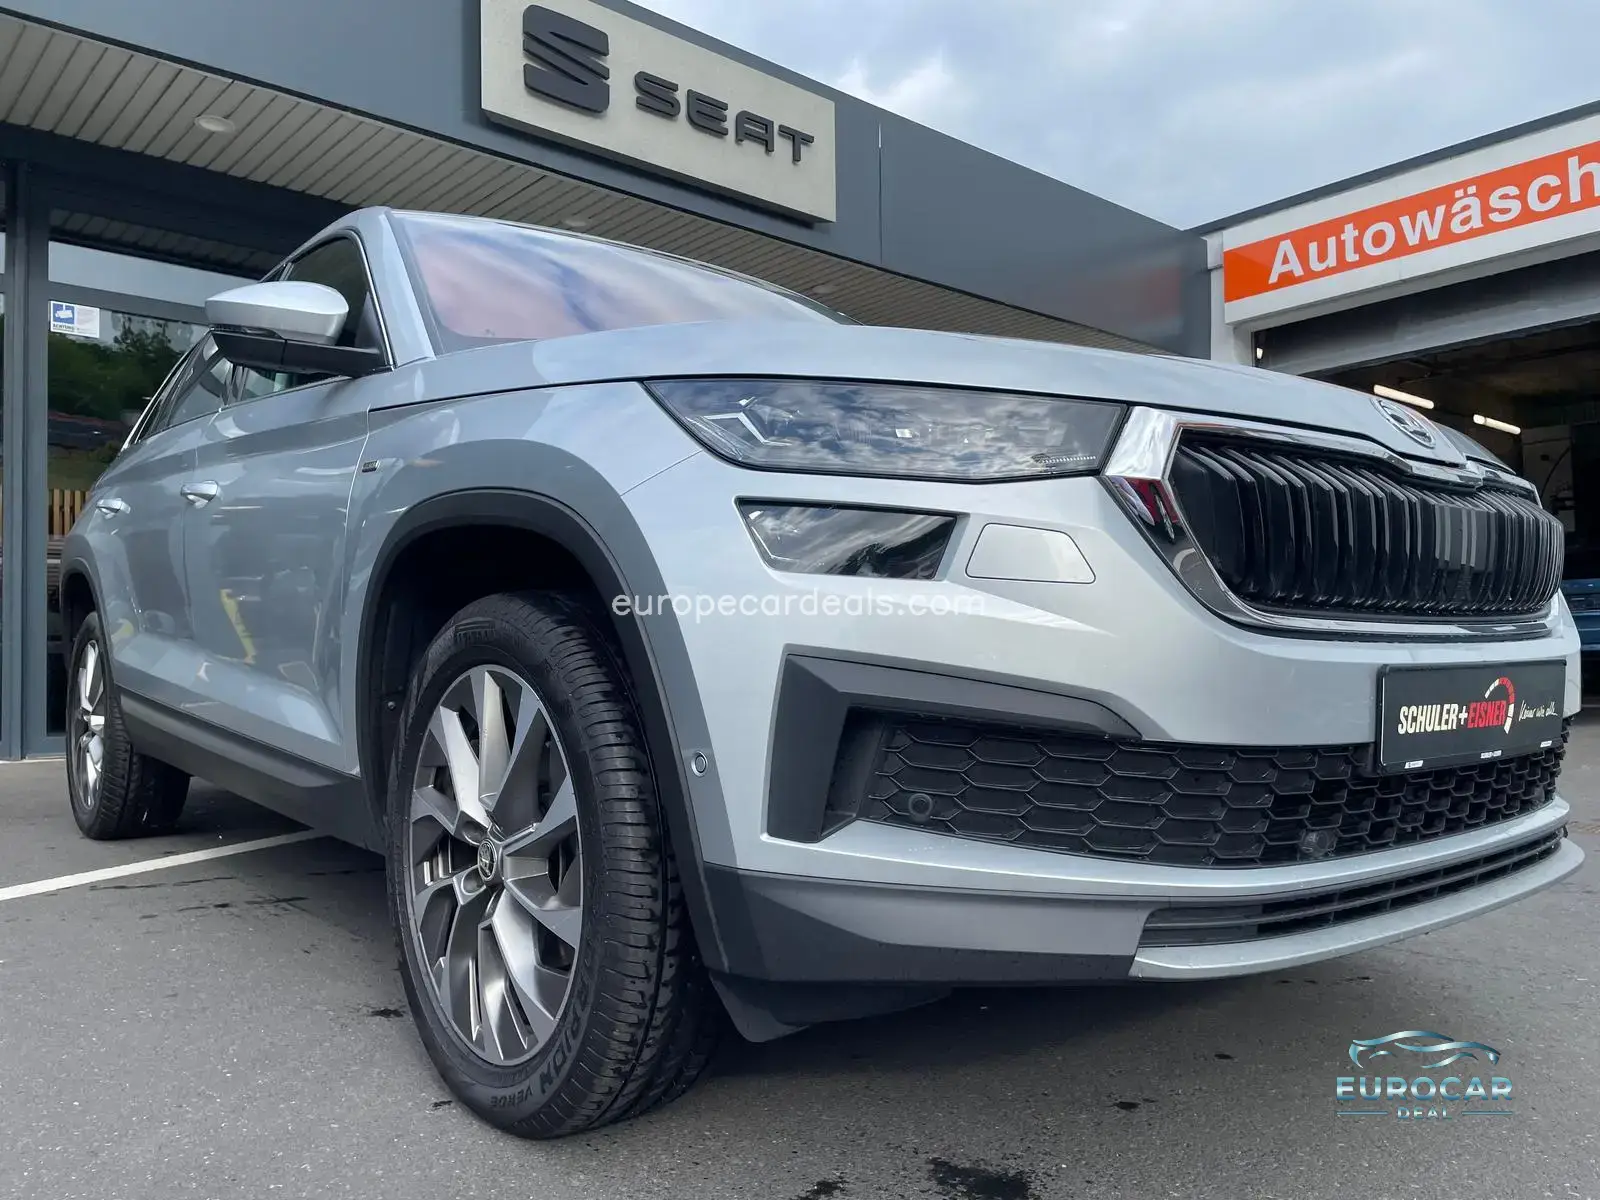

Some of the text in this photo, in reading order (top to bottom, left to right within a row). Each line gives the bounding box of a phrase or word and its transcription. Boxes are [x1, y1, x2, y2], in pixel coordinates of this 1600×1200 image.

[634, 70, 815, 163] SEAT
[1268, 155, 1600, 284] Autowäsch
[490, 1086, 533, 1109] VERDE
